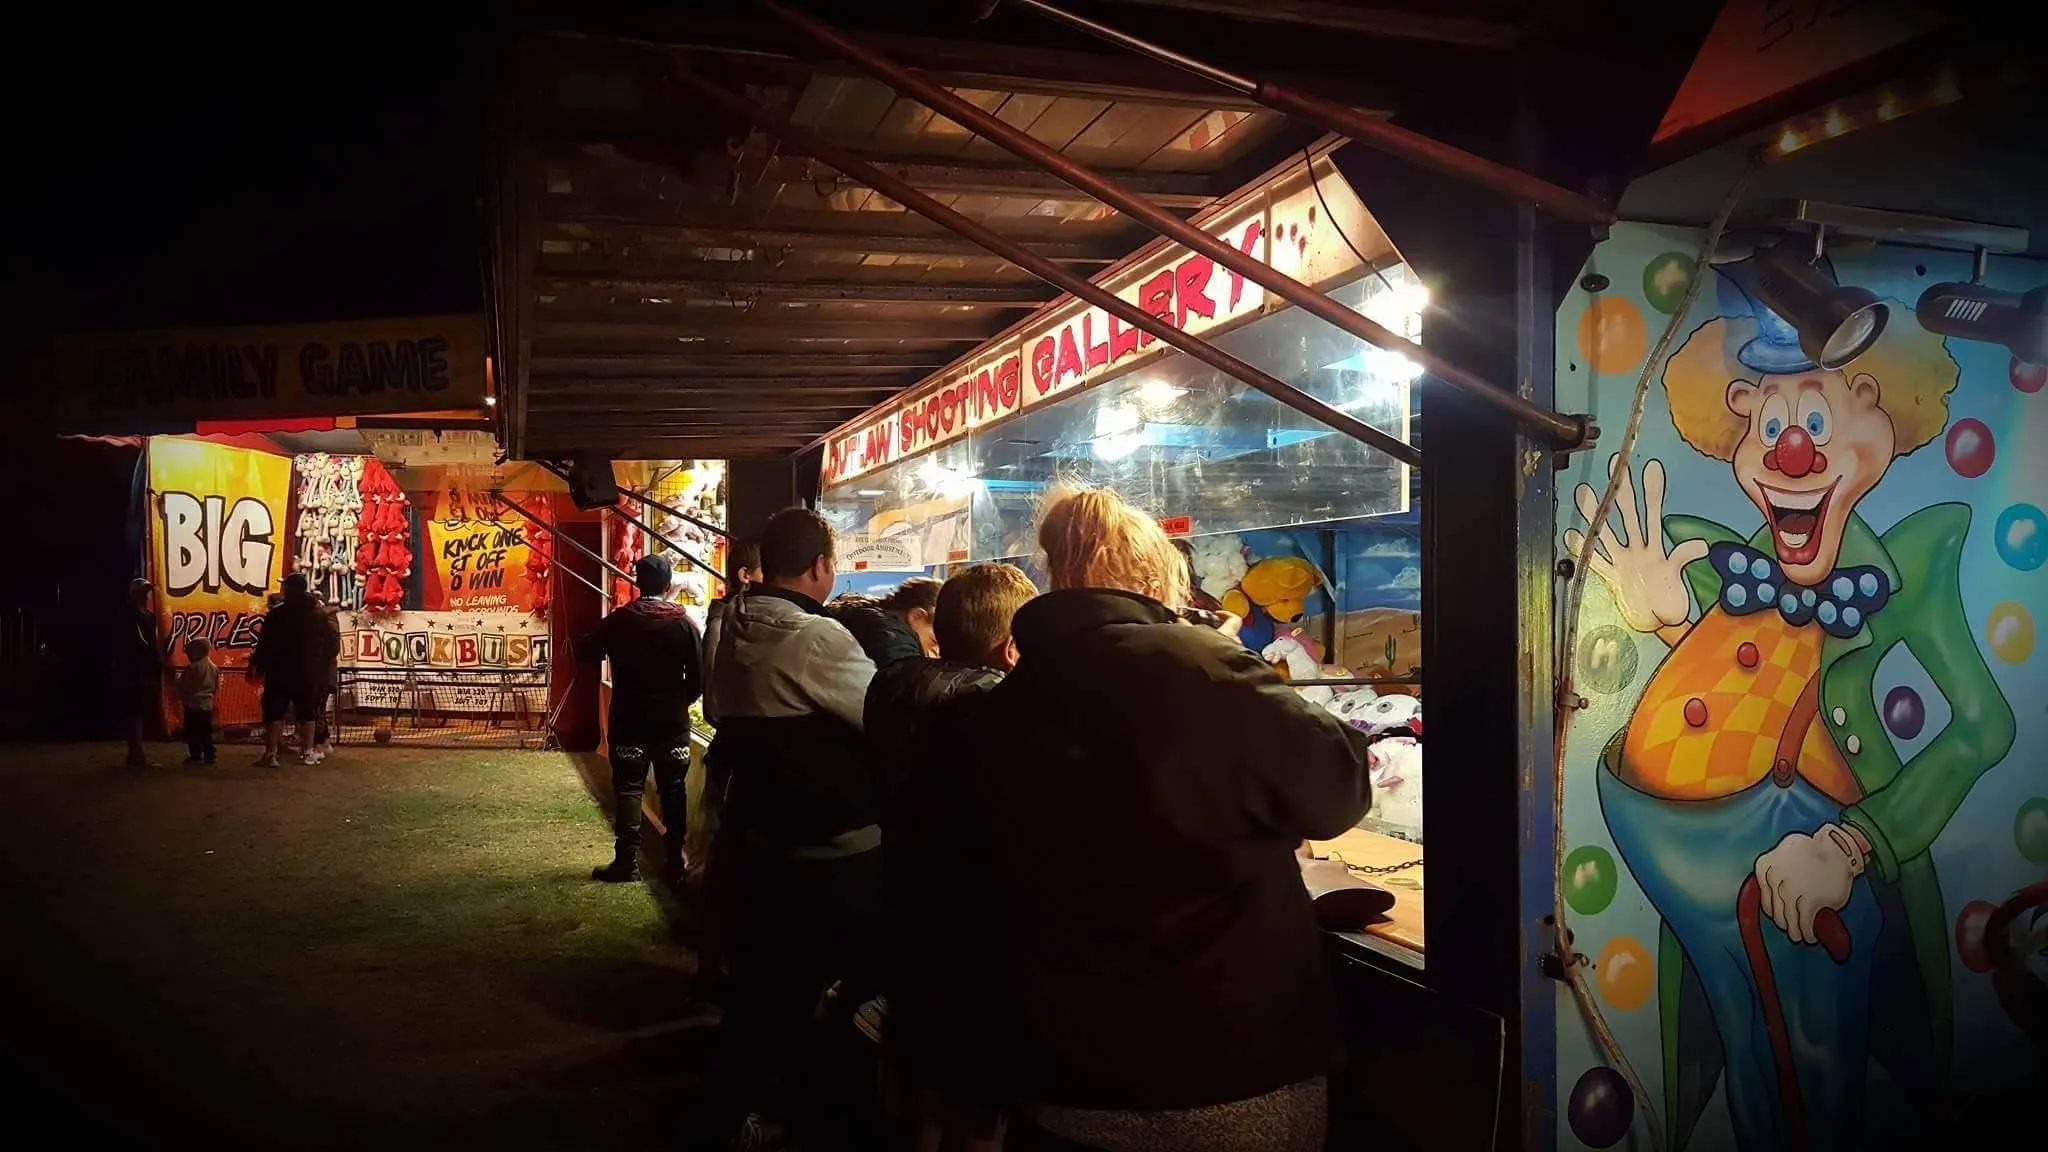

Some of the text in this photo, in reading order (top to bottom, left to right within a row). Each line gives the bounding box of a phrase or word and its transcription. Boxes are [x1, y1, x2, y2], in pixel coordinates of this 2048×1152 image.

[901, 355, 1020, 452] SHOOTING
[1032, 220, 1261, 396] GALLERY
[300, 335, 449, 396] GAME
[160, 491, 275, 597] BIG
[477, 549, 507, 570] OFF
[465, 594, 507, 606] LEANING
[469, 568, 504, 591] WIN
[166, 611, 265, 653] PRIZES
